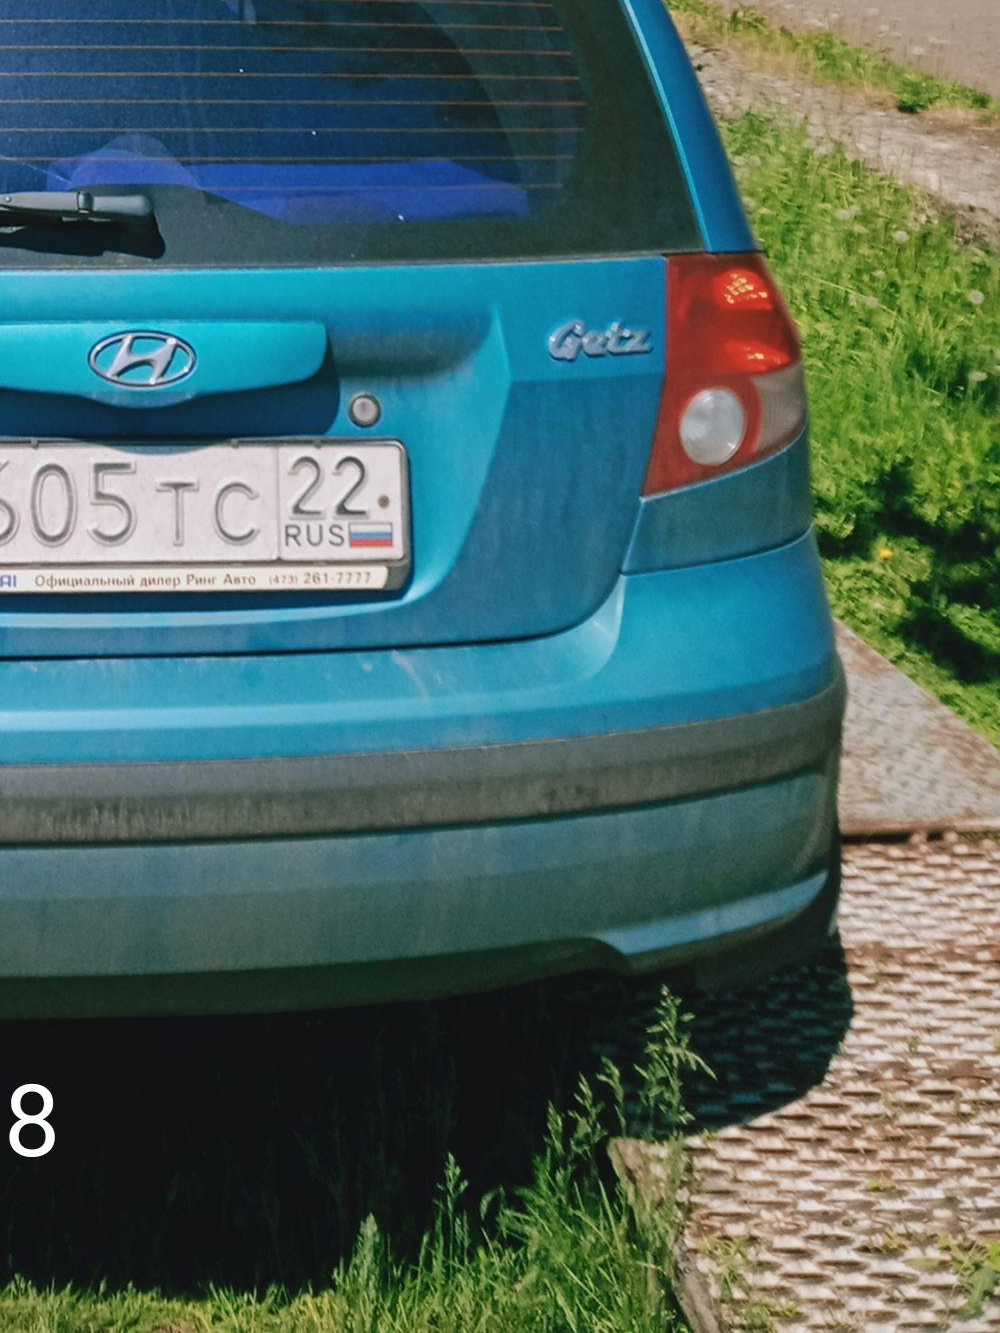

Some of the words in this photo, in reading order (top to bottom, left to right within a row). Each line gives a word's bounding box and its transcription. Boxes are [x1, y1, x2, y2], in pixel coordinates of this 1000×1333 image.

[547, 318, 655, 362] Getz
[286, 454, 371, 520] 22
[284, 523, 346, 548] RUS
[33, 574, 136, 589] Официальный
[139, 574, 181, 588] дилер
[186, 573, 217, 587] Ринг
[223, 573, 257, 586] Авто
[303, 571, 373, 586] 261-7777
